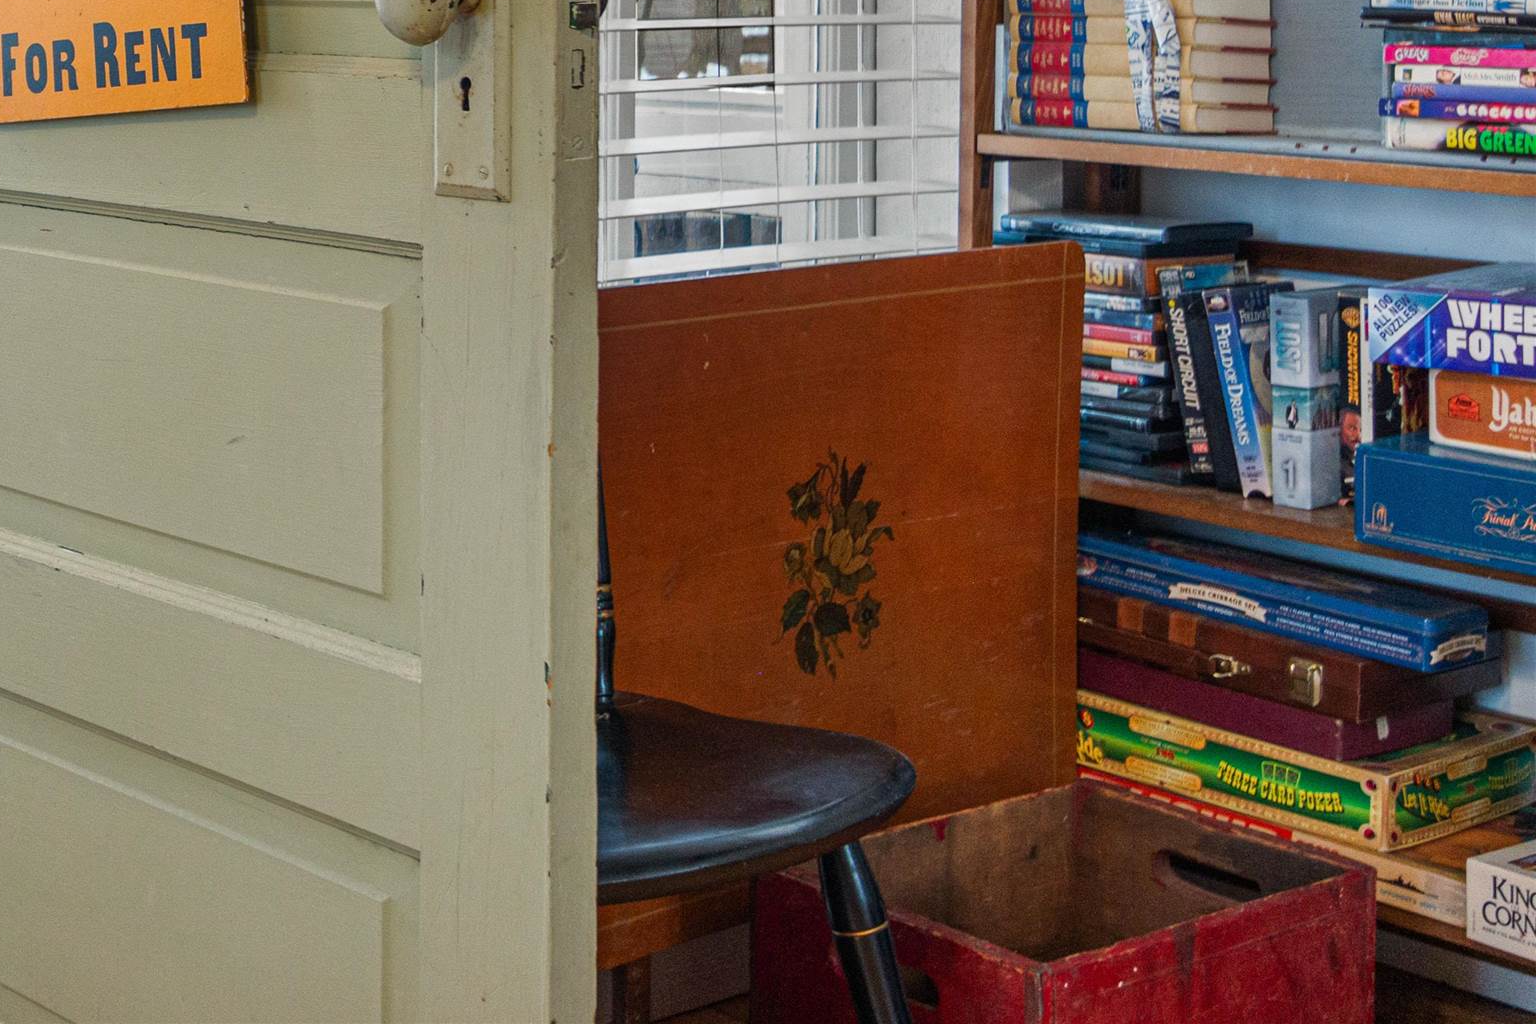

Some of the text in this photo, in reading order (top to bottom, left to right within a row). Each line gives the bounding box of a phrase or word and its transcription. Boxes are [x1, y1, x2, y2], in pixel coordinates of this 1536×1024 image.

[0, 32, 80, 98] FOR
[1393, 47, 1430, 63] GREASE
[1445, 127, 1536, 155] BIG GREEN
[1372, 293, 1411, 332] ALL NEW
[1373, 294, 1394, 314] 100
[1446, 297, 1536, 335] WHEE
[1168, 307, 1190, 358] SHORT
[1275, 321, 1302, 374] LOST
[1446, 326, 1536, 367] FORT
[1176, 356, 1201, 411] CIRCUIT
[1214, 322, 1251, 446] FIELD OF DREAMS
[1347, 329, 1360, 407] SHOWTIME
[1481, 508, 1520, 528] Trivial
[1179, 586, 1257, 612] DELUXE CRIBBAGE SET
[1215, 759, 1258, 797] THREE
[1259, 781, 1295, 807] CARD
[1297, 788, 1345, 814] POKER
[1481, 900, 1536, 938] CORN
